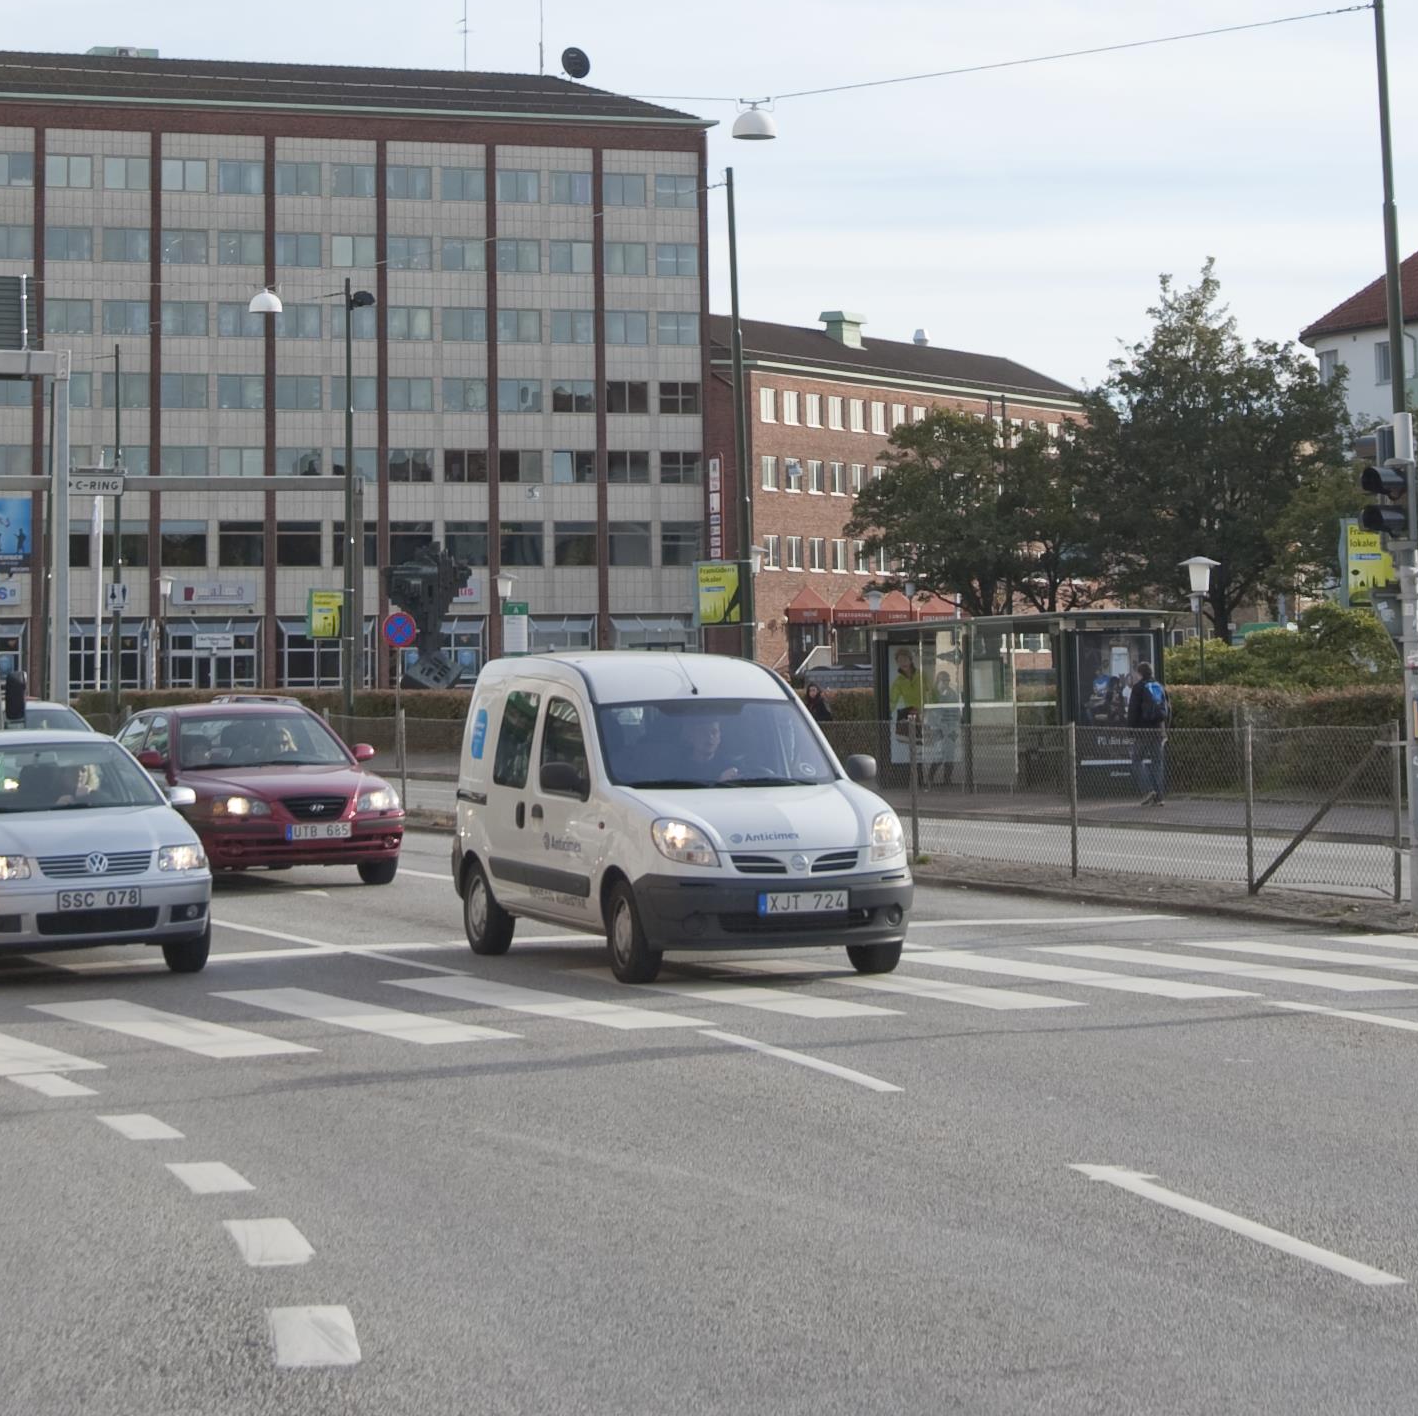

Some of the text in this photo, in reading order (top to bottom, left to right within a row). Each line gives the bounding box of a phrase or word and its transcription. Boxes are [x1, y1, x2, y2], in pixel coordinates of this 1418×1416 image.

[75, 480, 119, 490] C-RING
[1349, 538, 1377, 547] lokaler
[293, 825, 318, 838] UTB
[745, 832, 799, 842] Anticimex
[61, 889, 137, 909] SSC 078
[769, 893, 844, 912] XJT 724
